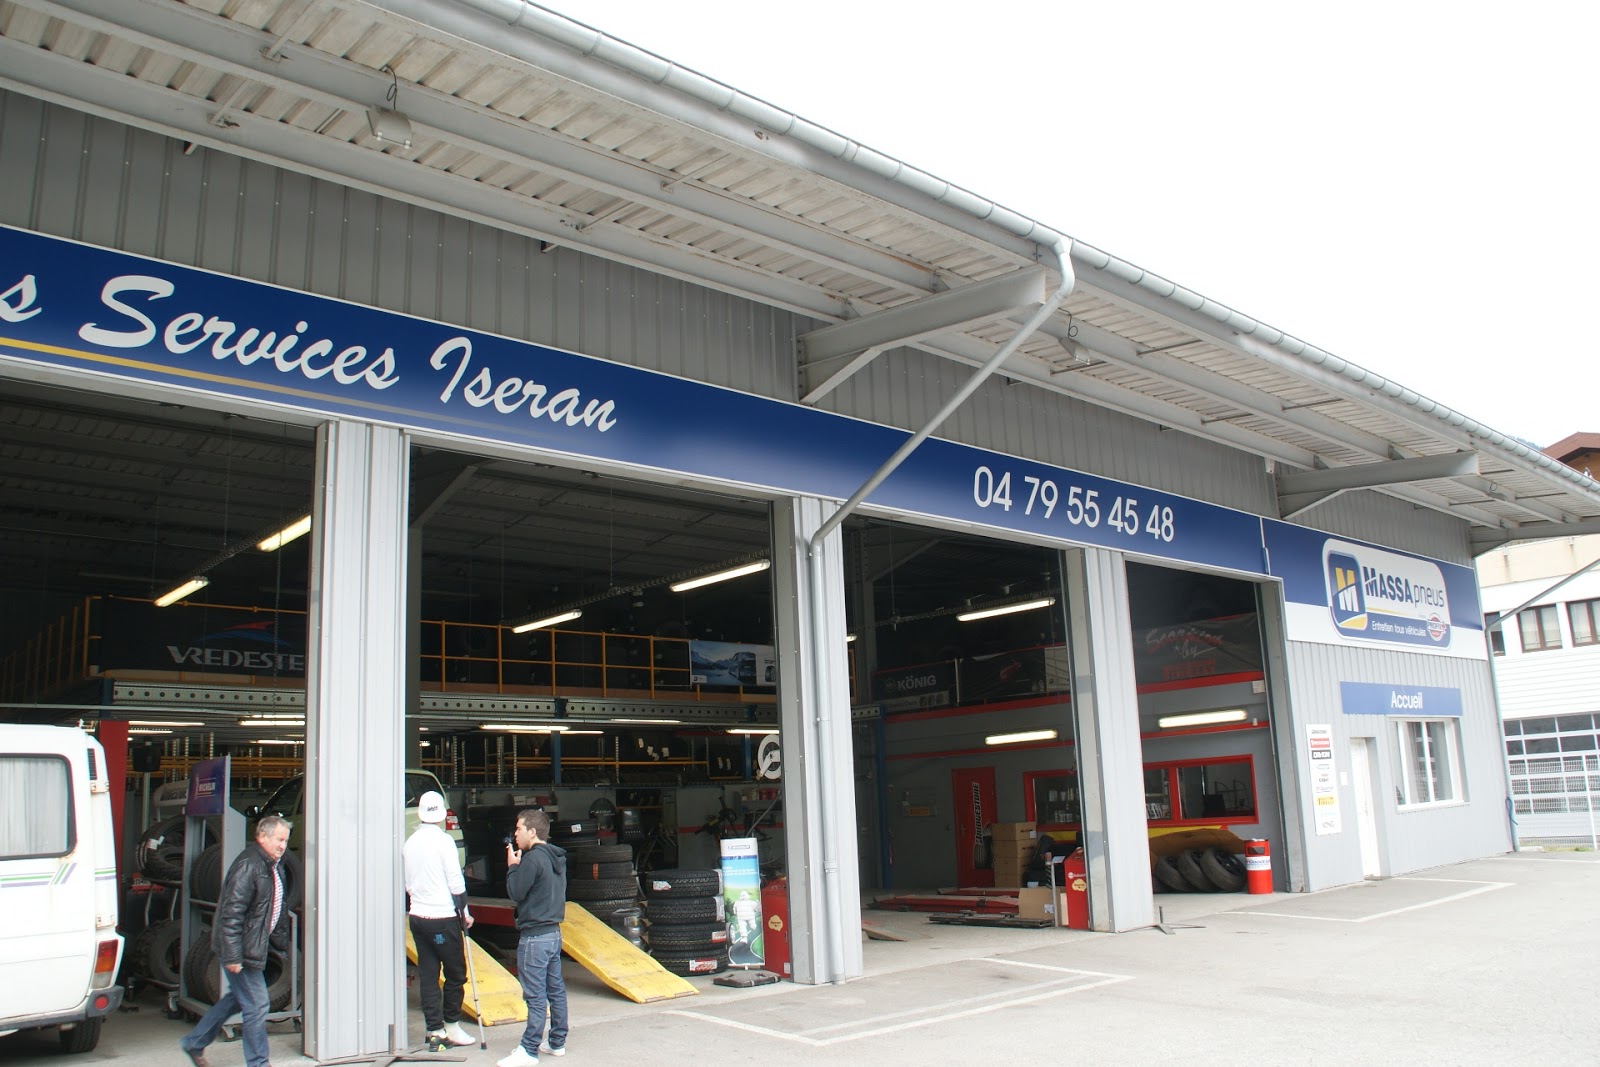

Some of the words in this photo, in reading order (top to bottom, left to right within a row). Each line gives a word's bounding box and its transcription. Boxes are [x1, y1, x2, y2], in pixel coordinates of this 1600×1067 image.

[78, 275, 400, 390] Services
[430, 336, 617, 432] Iseran
[973, 465, 1013, 512] 04
[1024, 475, 1059, 519] 79
[1066, 486, 1100, 528] 55
[1107, 496, 1139, 535] 45
[1145, 504, 1175, 543] 48
[1362, 566, 1414, 604] MASSA
[1413, 585, 1445, 608] pneus
[1371, 620, 1393, 632] Entretien
[1394, 624, 1405, 633] tous
[1405, 624, 1427, 637] véhicules
[897, 675, 937, 690] KÖNIG
[1391, 690, 1423, 709] Accueil
